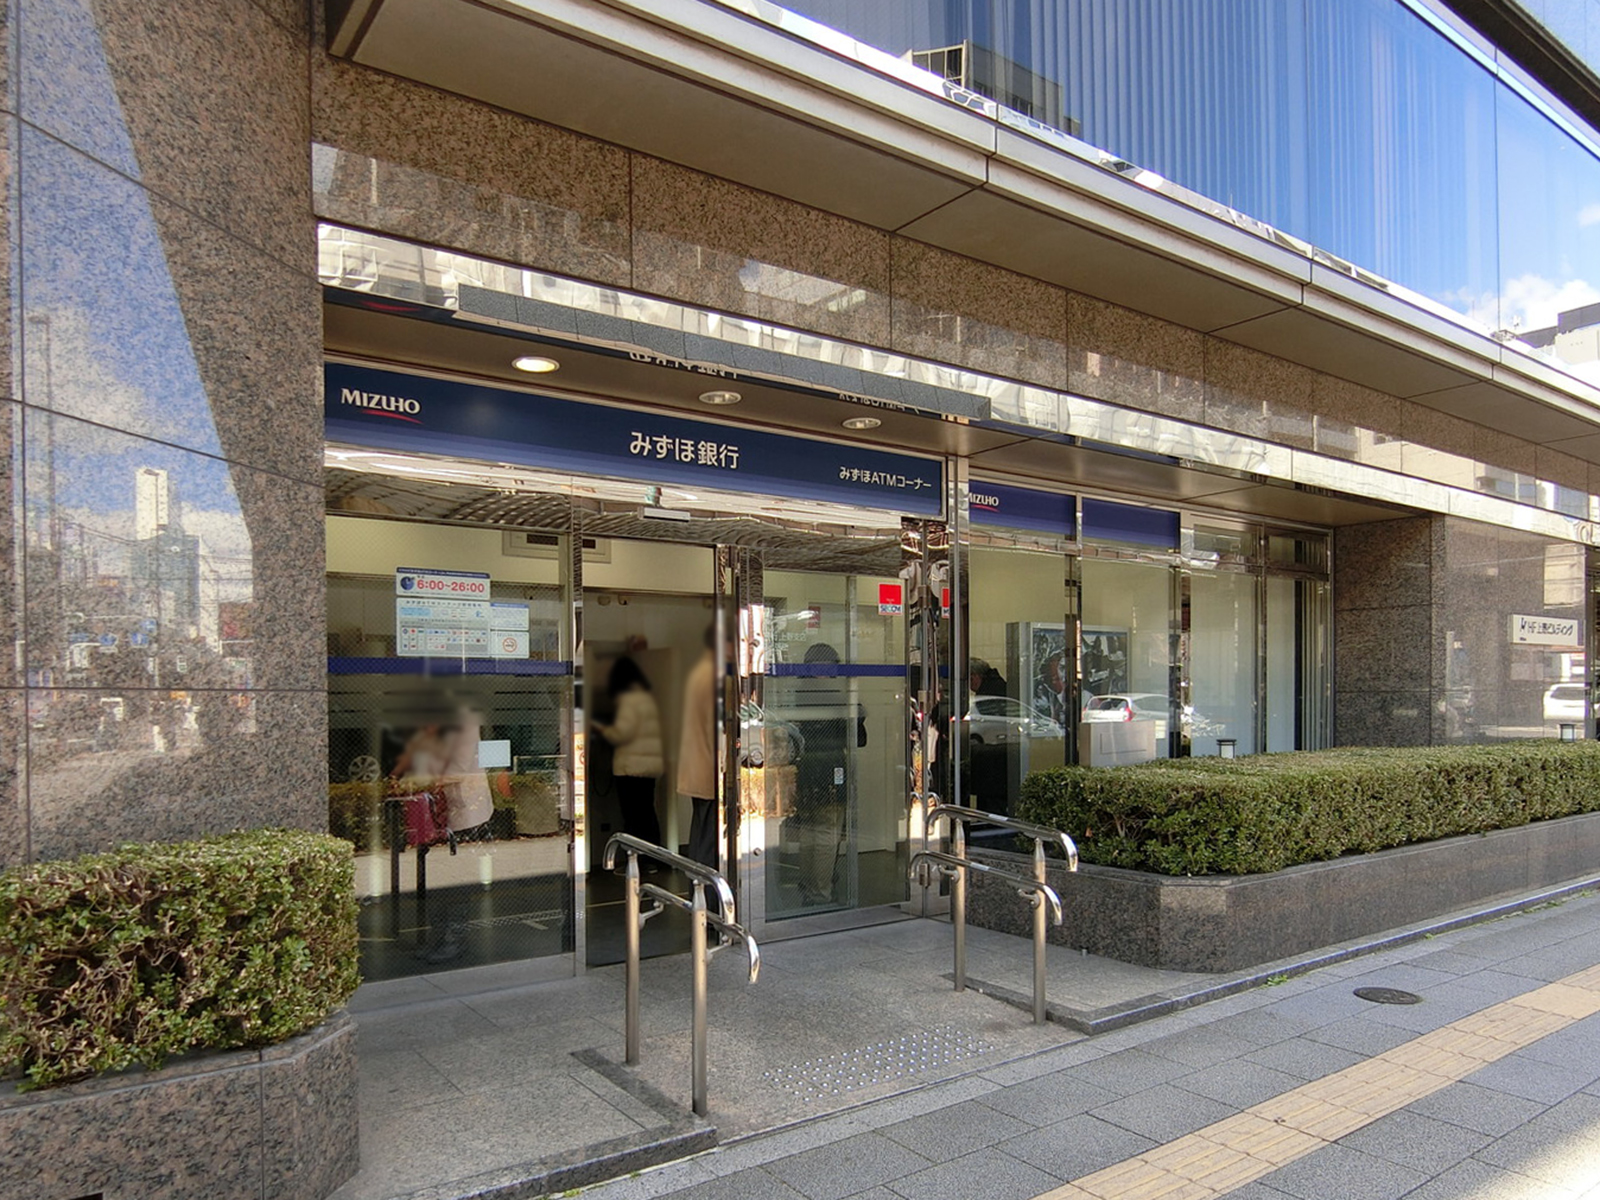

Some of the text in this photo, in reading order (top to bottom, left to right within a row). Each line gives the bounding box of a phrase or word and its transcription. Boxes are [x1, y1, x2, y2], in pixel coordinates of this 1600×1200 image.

[341, 387, 421, 415] MIZUHO
[629, 431, 740, 470] みずほ銀行
[839, 466, 932, 490] みずほATMコーナー
